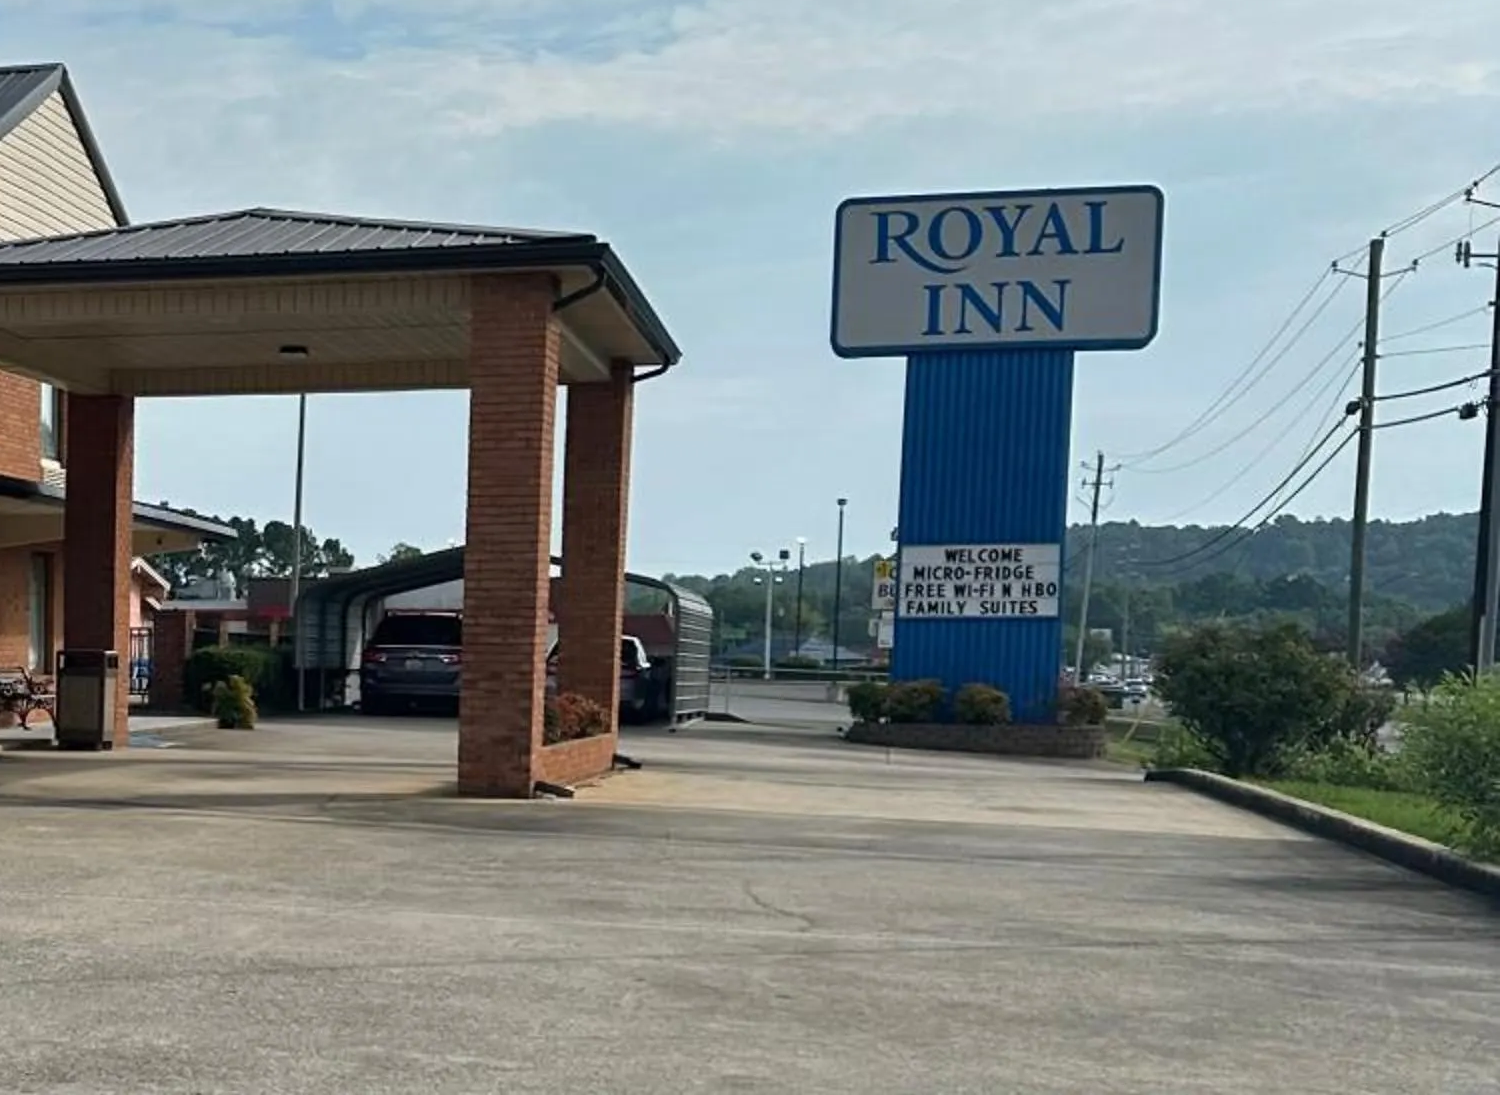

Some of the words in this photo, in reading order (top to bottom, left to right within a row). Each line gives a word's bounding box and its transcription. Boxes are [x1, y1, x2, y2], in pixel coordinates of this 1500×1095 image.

[868, 199, 1125, 274] ROYAL
[921, 279, 1071, 336] INN
[944, 548, 1023, 563] WELCOME
[912, 565, 1035, 580] MICRO-FRIDGE
[904, 583, 946, 597] FREE
[953, 583, 996, 597] WI-FI
[1002, 583, 1012, 597] N
[1021, 582, 1057, 597] HBO
[906, 600, 966, 614] FAMILY
[979, 600, 1038, 615] SUITES
